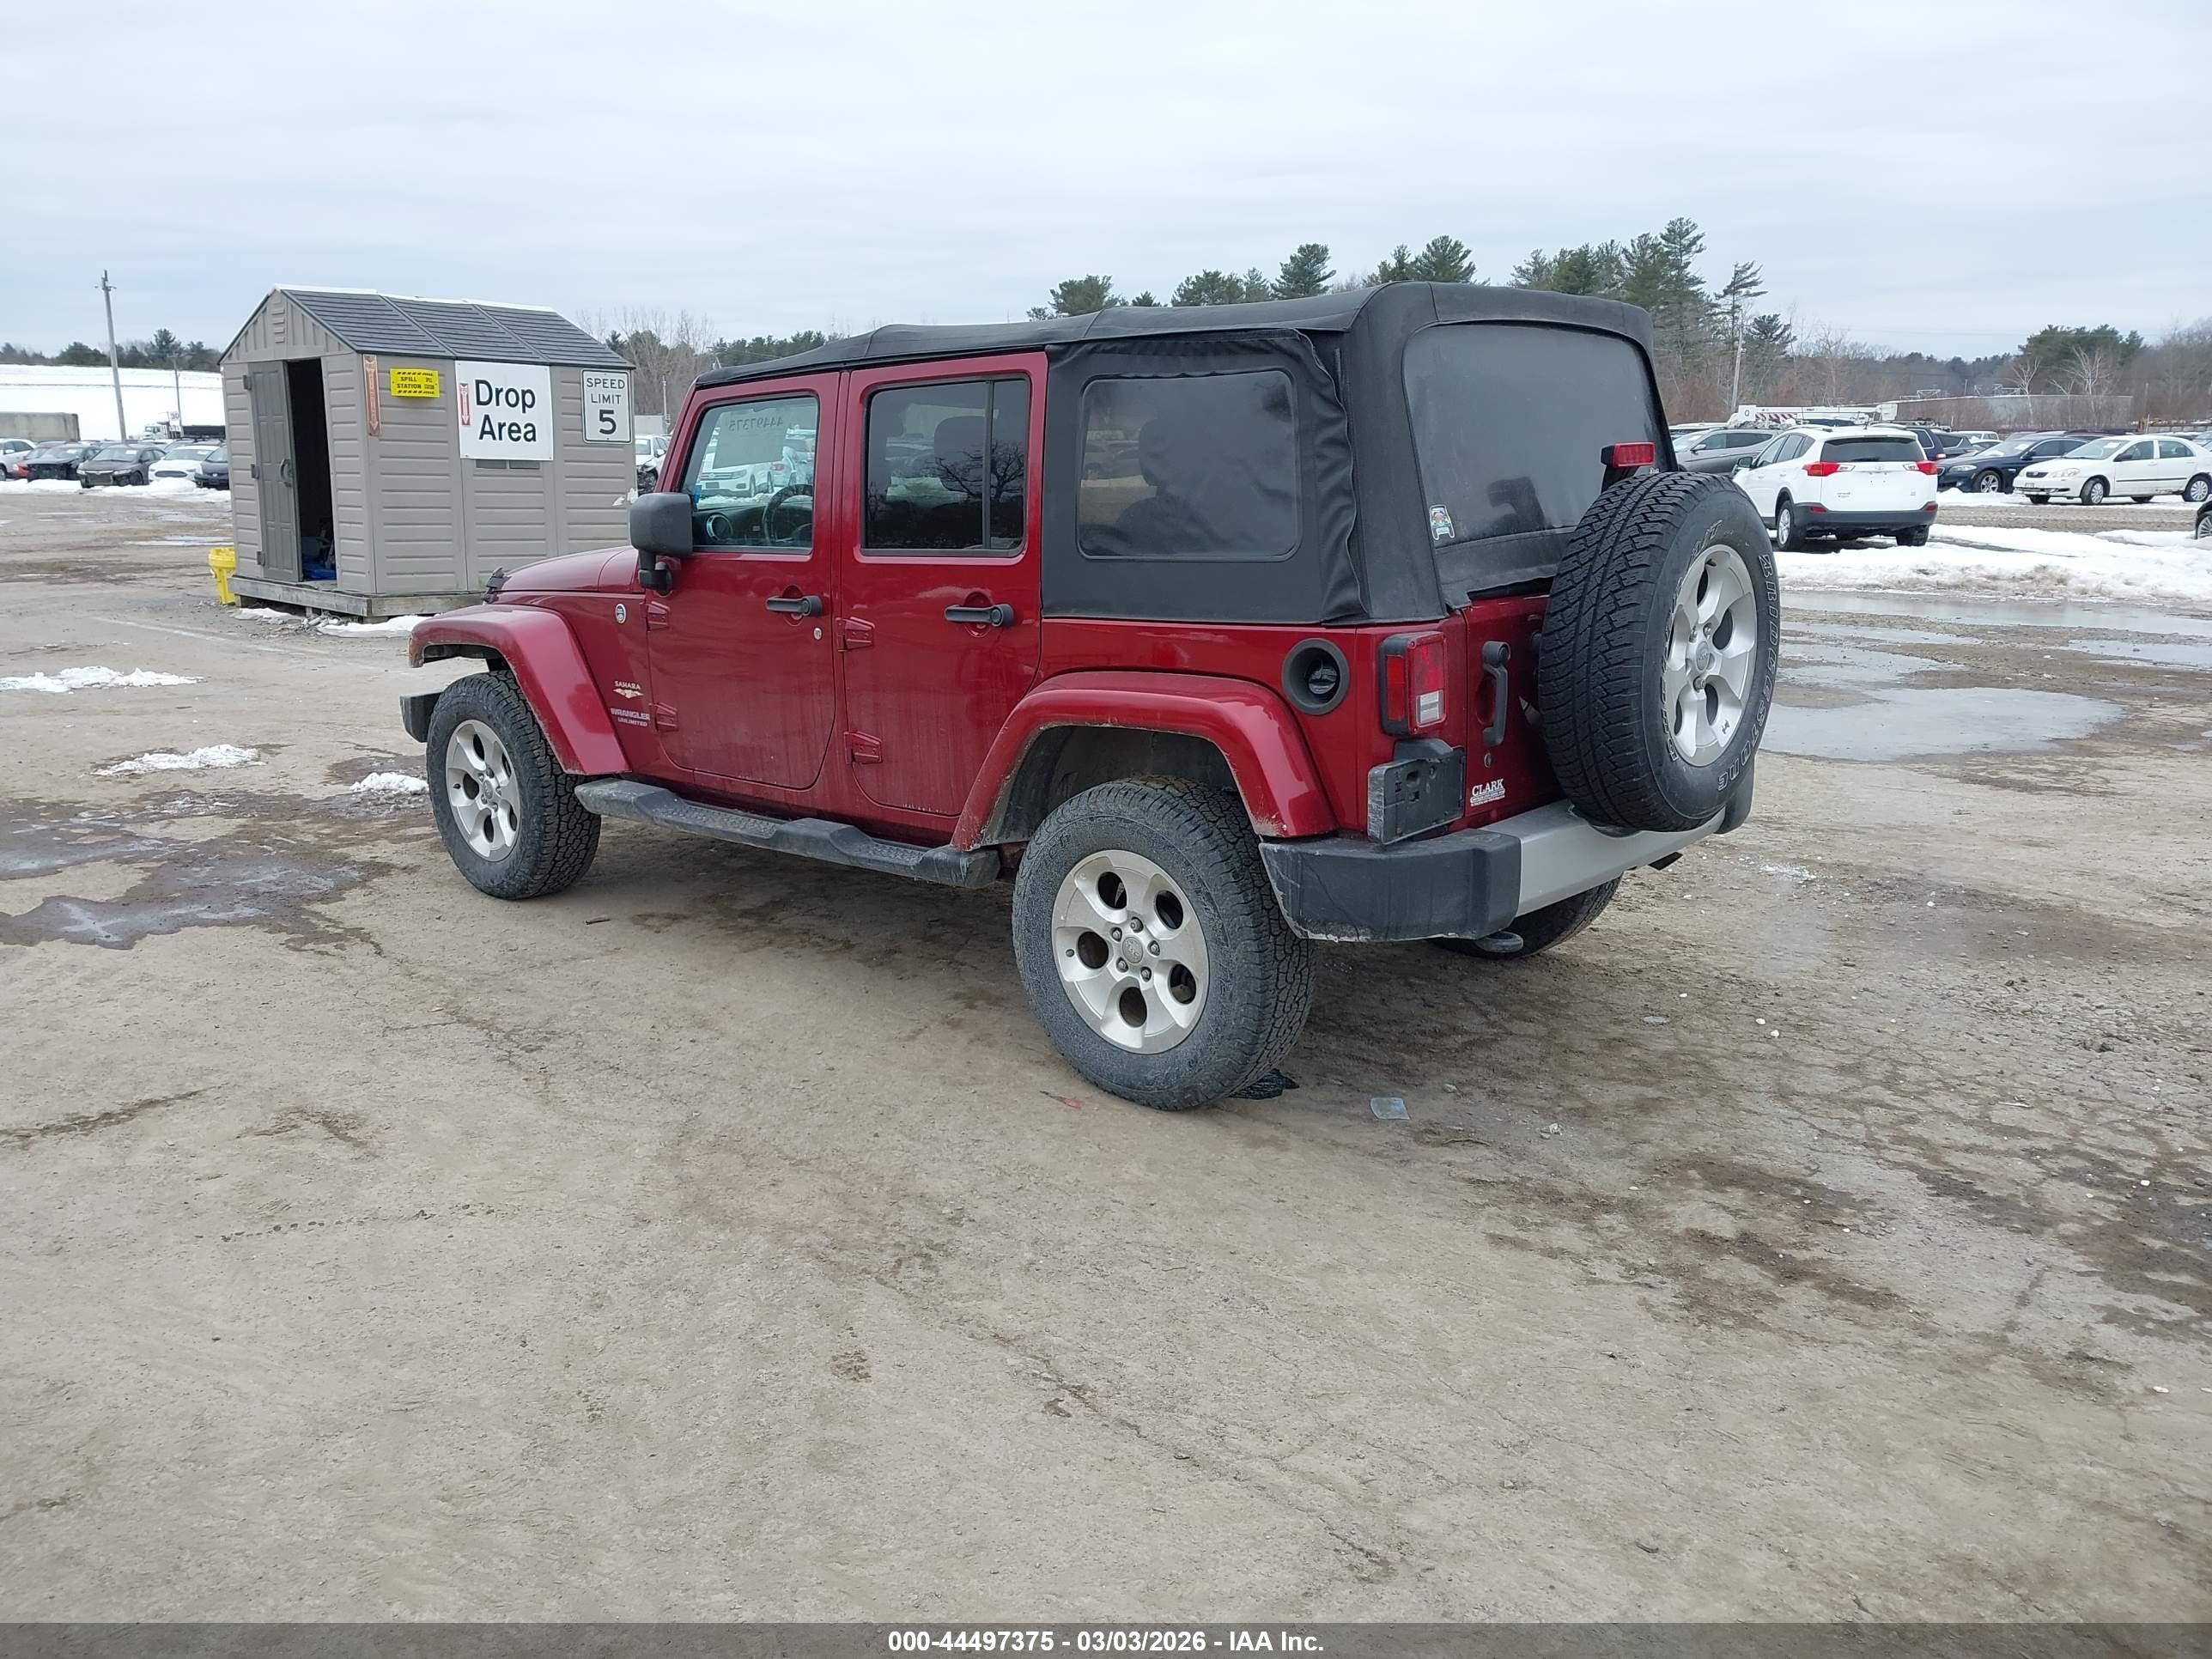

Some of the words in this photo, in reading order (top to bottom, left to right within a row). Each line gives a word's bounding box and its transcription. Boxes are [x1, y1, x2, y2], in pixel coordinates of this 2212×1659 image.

[586, 377, 625, 389] SPEED
[475, 379, 536, 414] Drop
[591, 393, 622, 404] LIMIT
[478, 414, 537, 442] Area
[599, 409, 617, 434] 5
[614, 680, 641, 690] SAHARA
[611, 707, 650, 721] WRANGLER
[617, 716, 647, 727] UNLIMITED
[1472, 778, 1504, 797] CLARK
